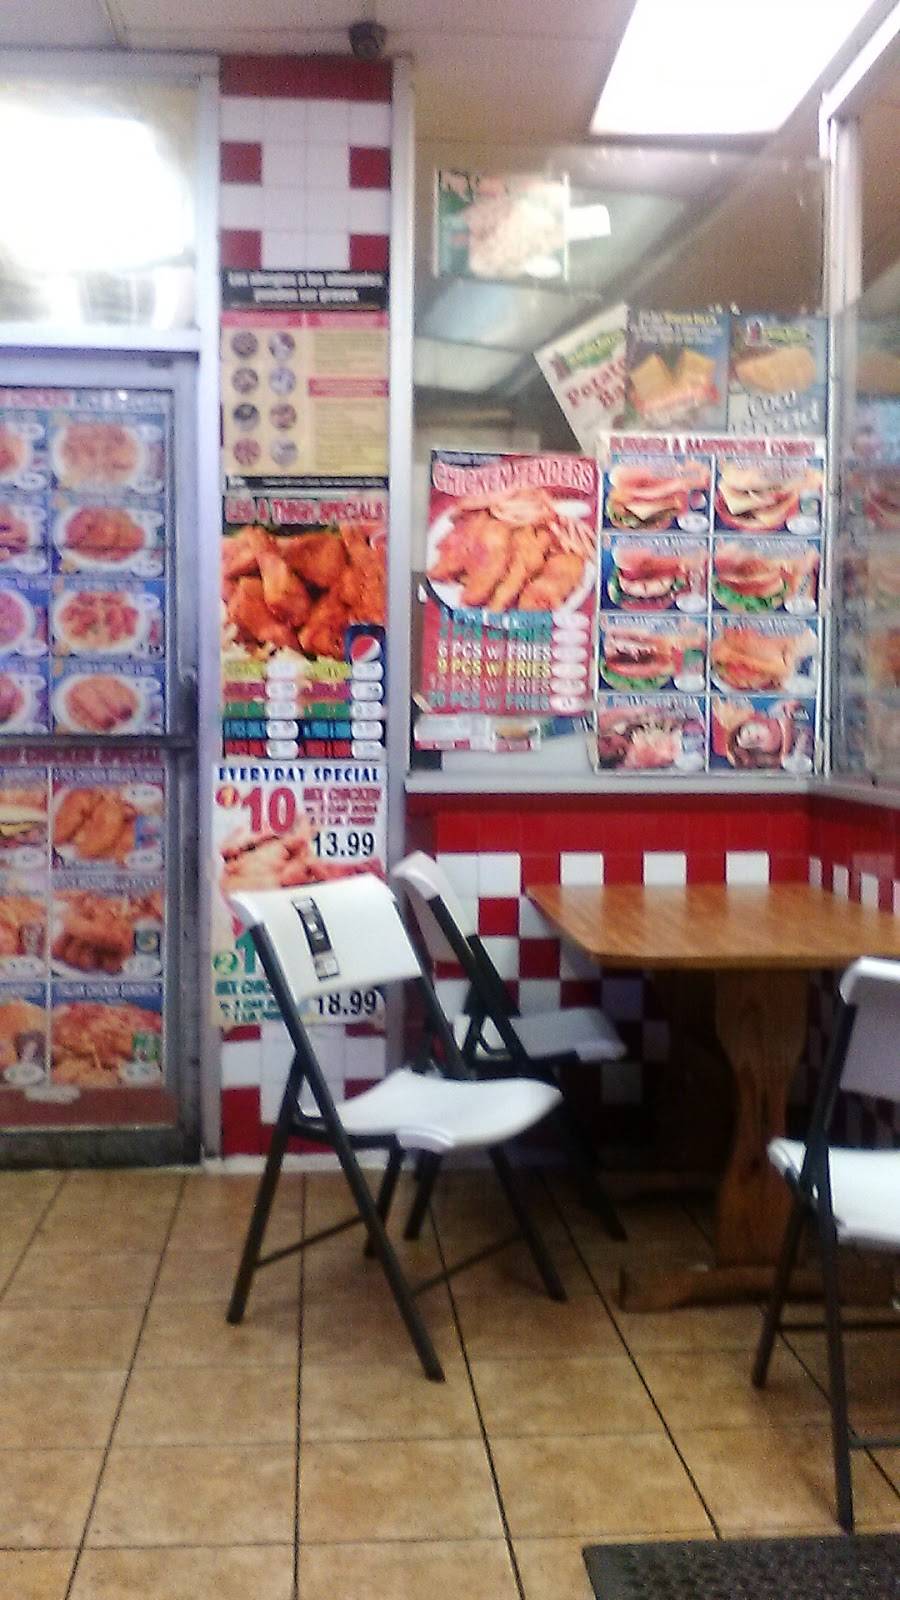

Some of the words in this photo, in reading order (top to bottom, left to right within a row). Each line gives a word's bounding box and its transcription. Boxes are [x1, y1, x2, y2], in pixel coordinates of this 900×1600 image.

[432, 460, 510, 497] CHICKEN
[509, 458, 597, 496] TENDERS
[438, 641, 449, 659] 6
[452, 641, 482, 660] PCS
[507, 642, 552, 661] FRIES
[452, 658, 482, 677] PCS
[507, 660, 552, 678] FRIES
[452, 675, 481, 692] PCS
[507, 676, 551, 694] FRIES
[506, 693, 551, 711] FRIES
[218, 767, 304, 781] EVERYDAY
[314, 767, 378, 781] SPECIAL
[242, 787, 296, 834] 10
[312, 831, 376, 858] 13.99
[317, 990, 379, 1016] 18.99
